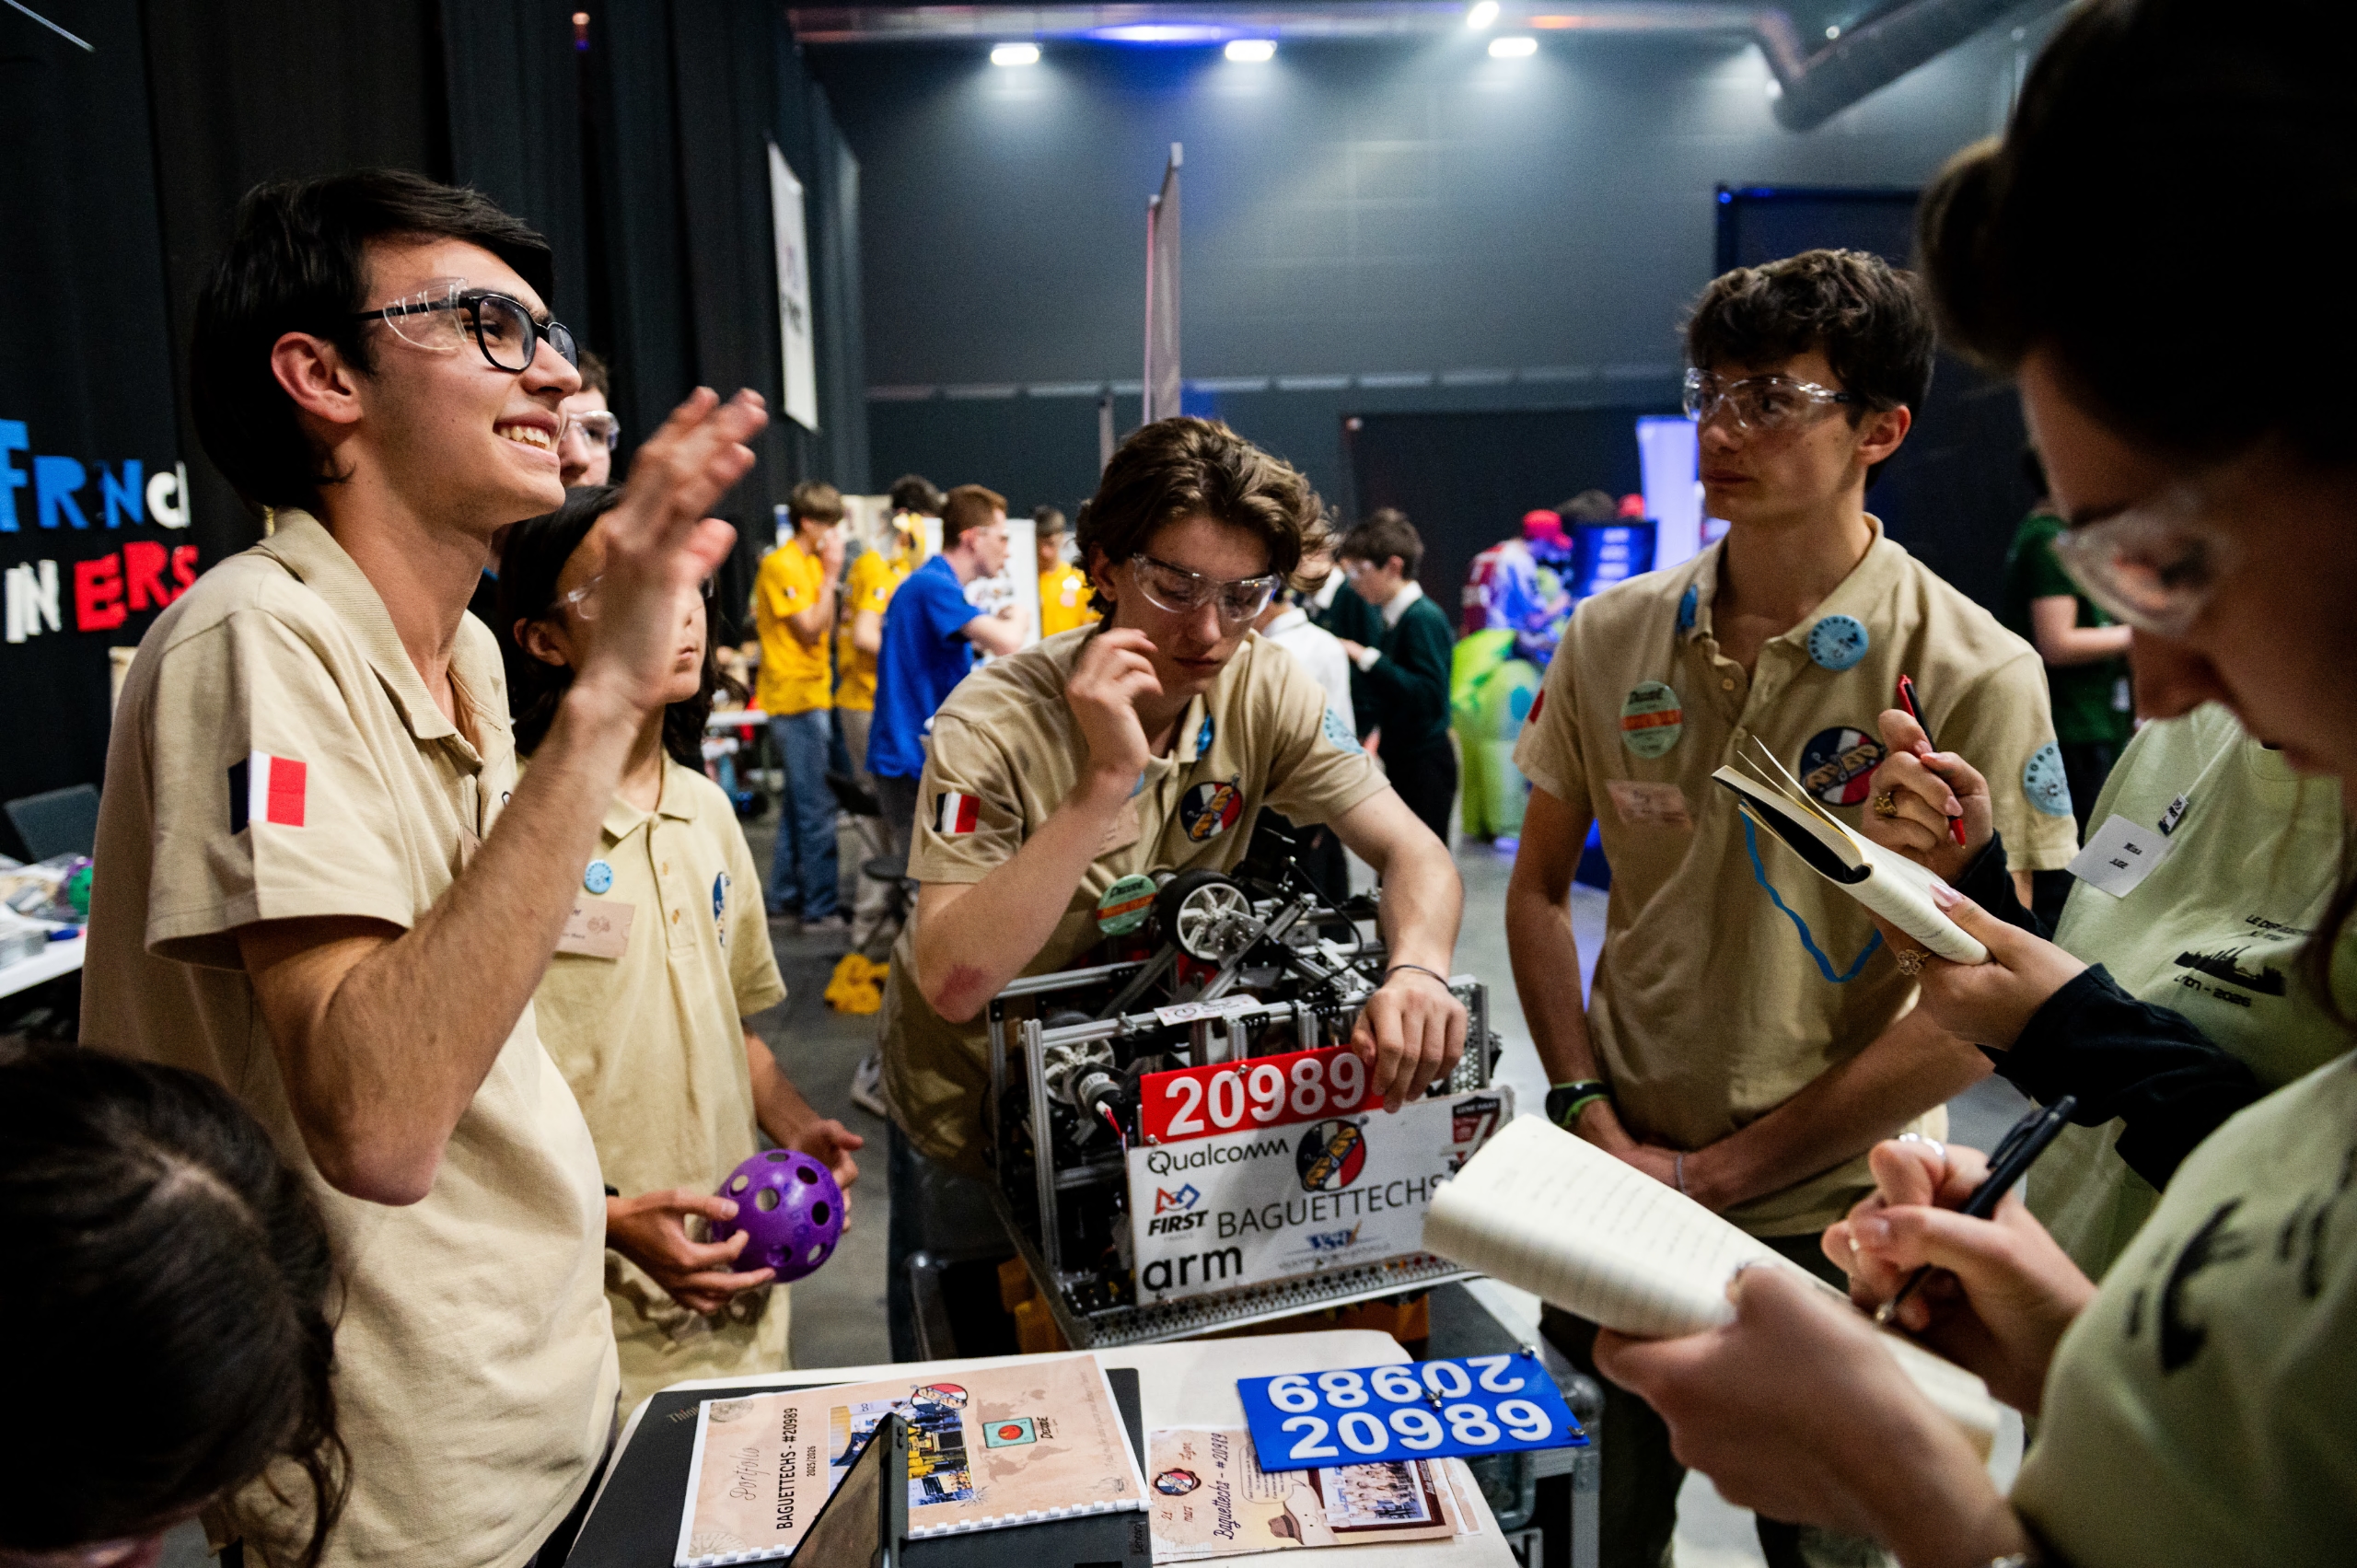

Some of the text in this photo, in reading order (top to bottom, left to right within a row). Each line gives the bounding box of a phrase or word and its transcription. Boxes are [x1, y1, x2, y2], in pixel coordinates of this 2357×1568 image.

[1165, 1052, 1365, 1137] 20989
[1147, 1138, 1289, 1177] Qualcomm
[1148, 1209, 1209, 1237] FIRST
[1142, 1246, 1242, 1291] arm
[1268, 1354, 1525, 1413] 20989
[782, 1407, 797, 1443] #20989
[1281, 1399, 1552, 1460] 20989
[729, 1447, 771, 1501] Portfolio
[806, 1446, 817, 1478] 2025/2026
[1211, 1433, 1229, 1469] #20989
[776, 1451, 796, 1530] BAGUETTECHS
[1208, 1481, 1240, 1540] Baguettechs
